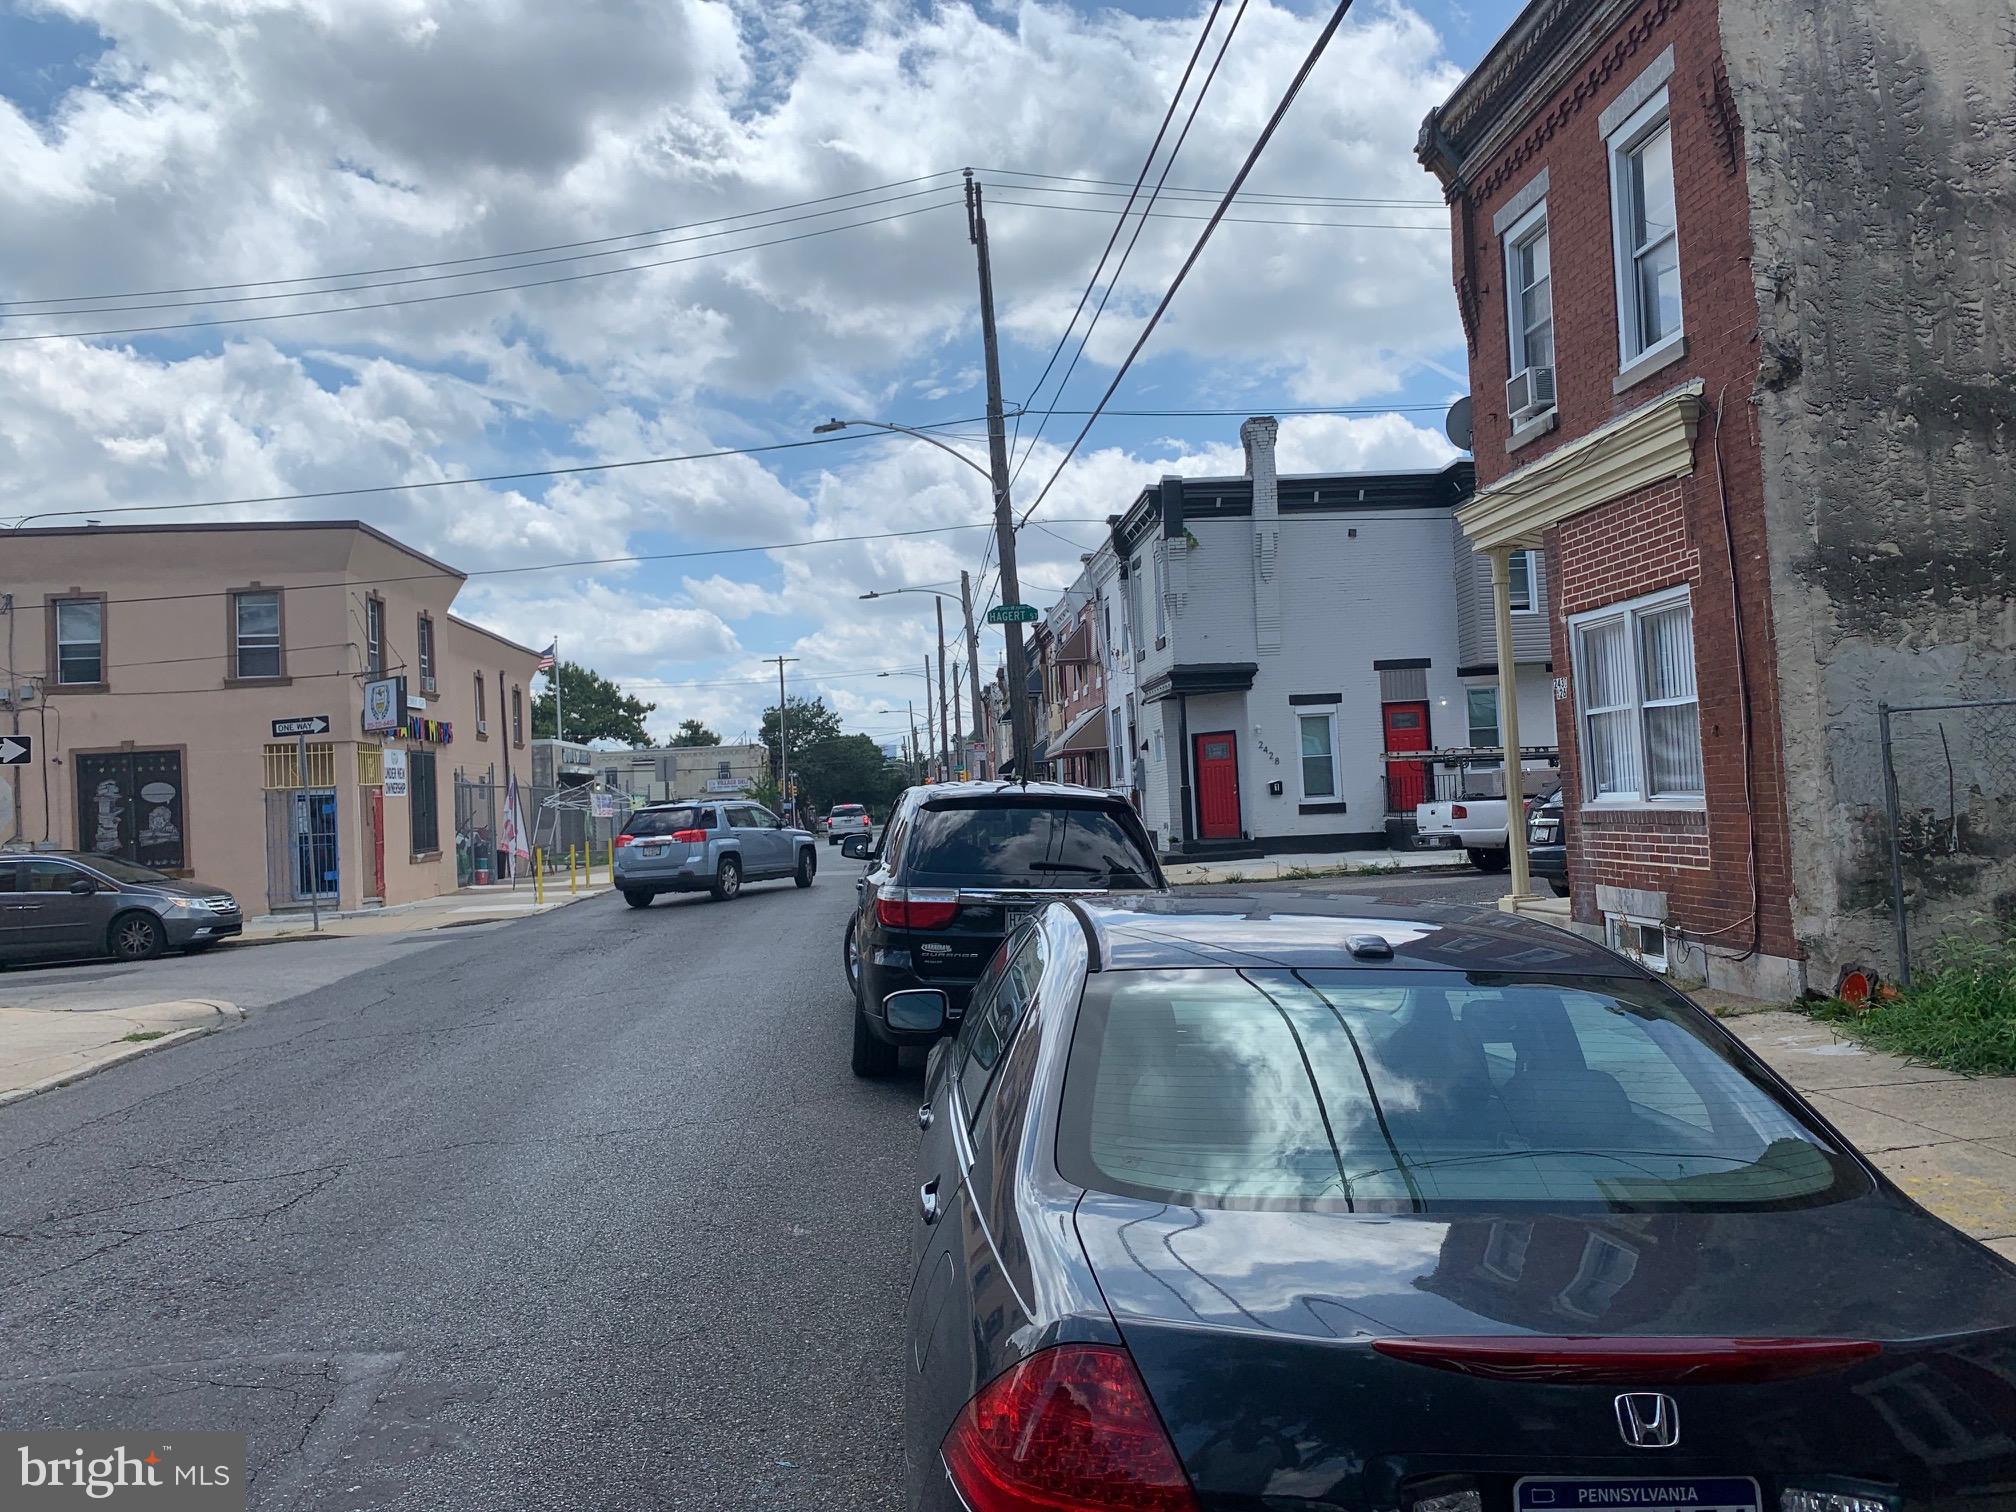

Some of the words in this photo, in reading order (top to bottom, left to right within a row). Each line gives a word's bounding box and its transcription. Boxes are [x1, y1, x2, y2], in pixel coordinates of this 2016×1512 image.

[989, 611, 1026, 622] HAGERT
[278, 723, 295, 732] ONE
[296, 721, 312, 730] WAY
[1258, 741, 1280, 765] 2428
[1578, 1487, 1699, 1503] PENNSYLVANIA
